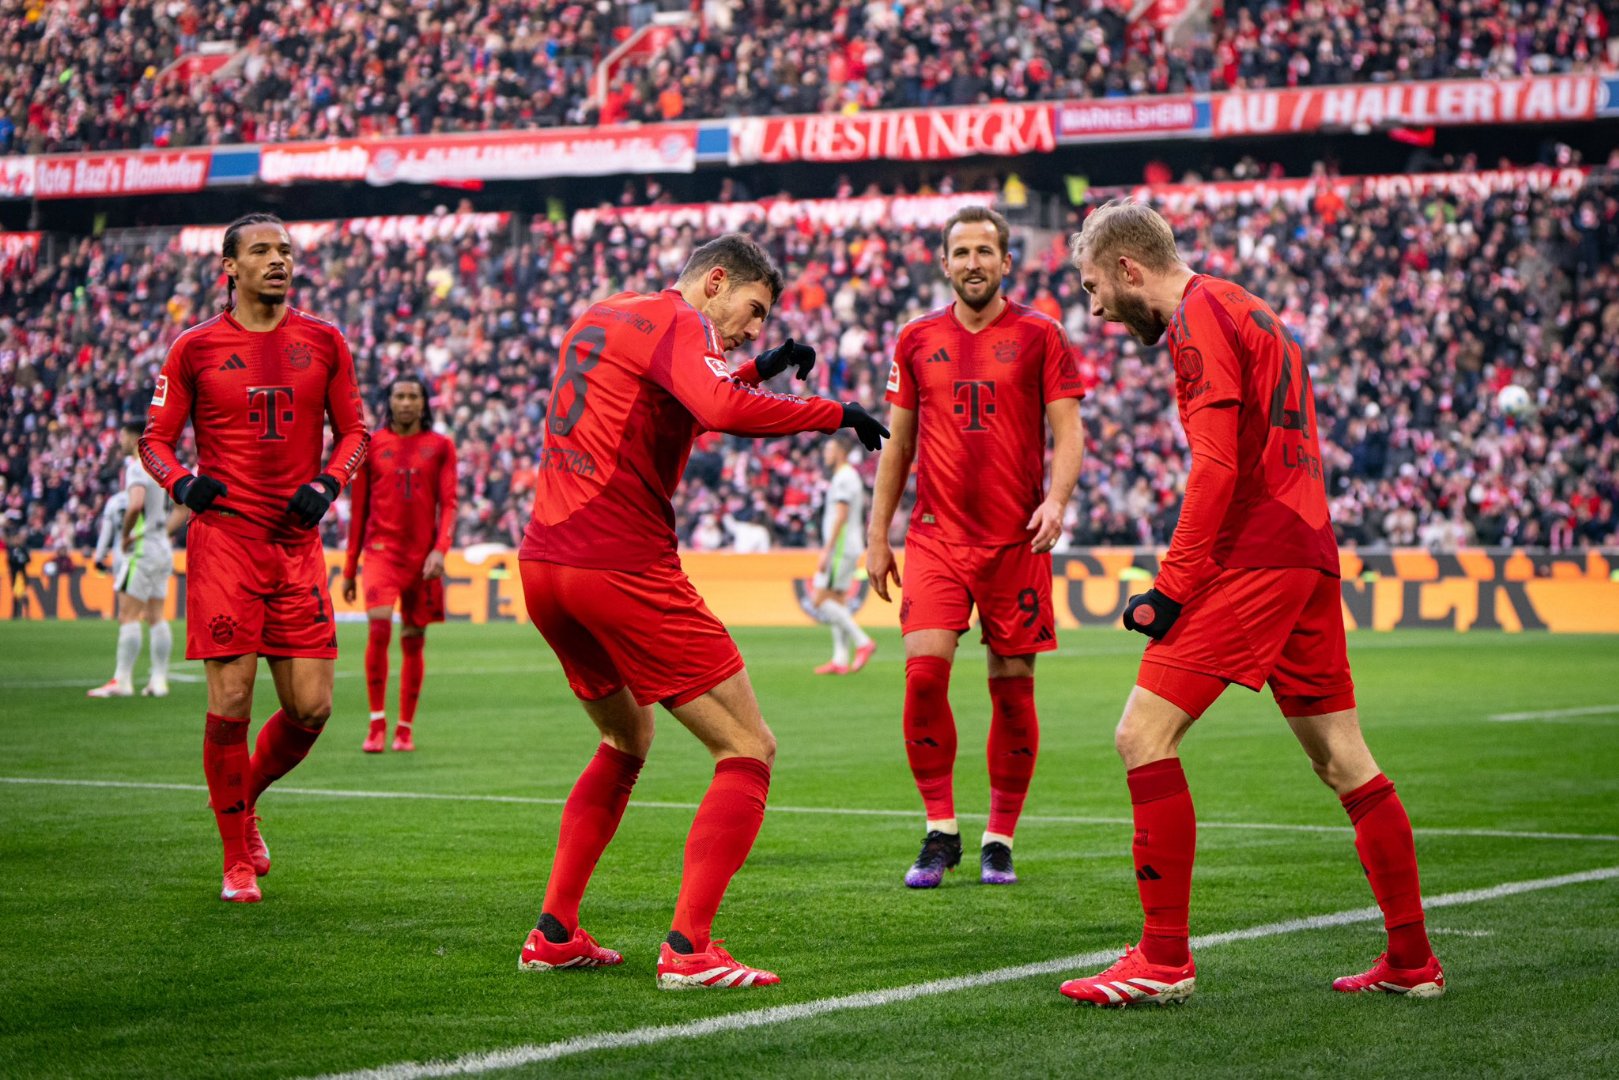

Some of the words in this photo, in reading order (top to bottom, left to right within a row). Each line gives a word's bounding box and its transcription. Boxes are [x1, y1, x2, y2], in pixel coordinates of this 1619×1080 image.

[800, 110, 924, 162] BESTIA
[928, 102, 1057, 159] NEGRA
[1061, 103, 1193, 130] MARKELSHEIM
[1217, 91, 1279, 132] AU
[1320, 77, 1588, 123] HALLERTAU
[548, 325, 606, 437] 8
[953, 380, 997, 433] T
[246, 386, 294, 441] T
[1018, 587, 1041, 628] 9
